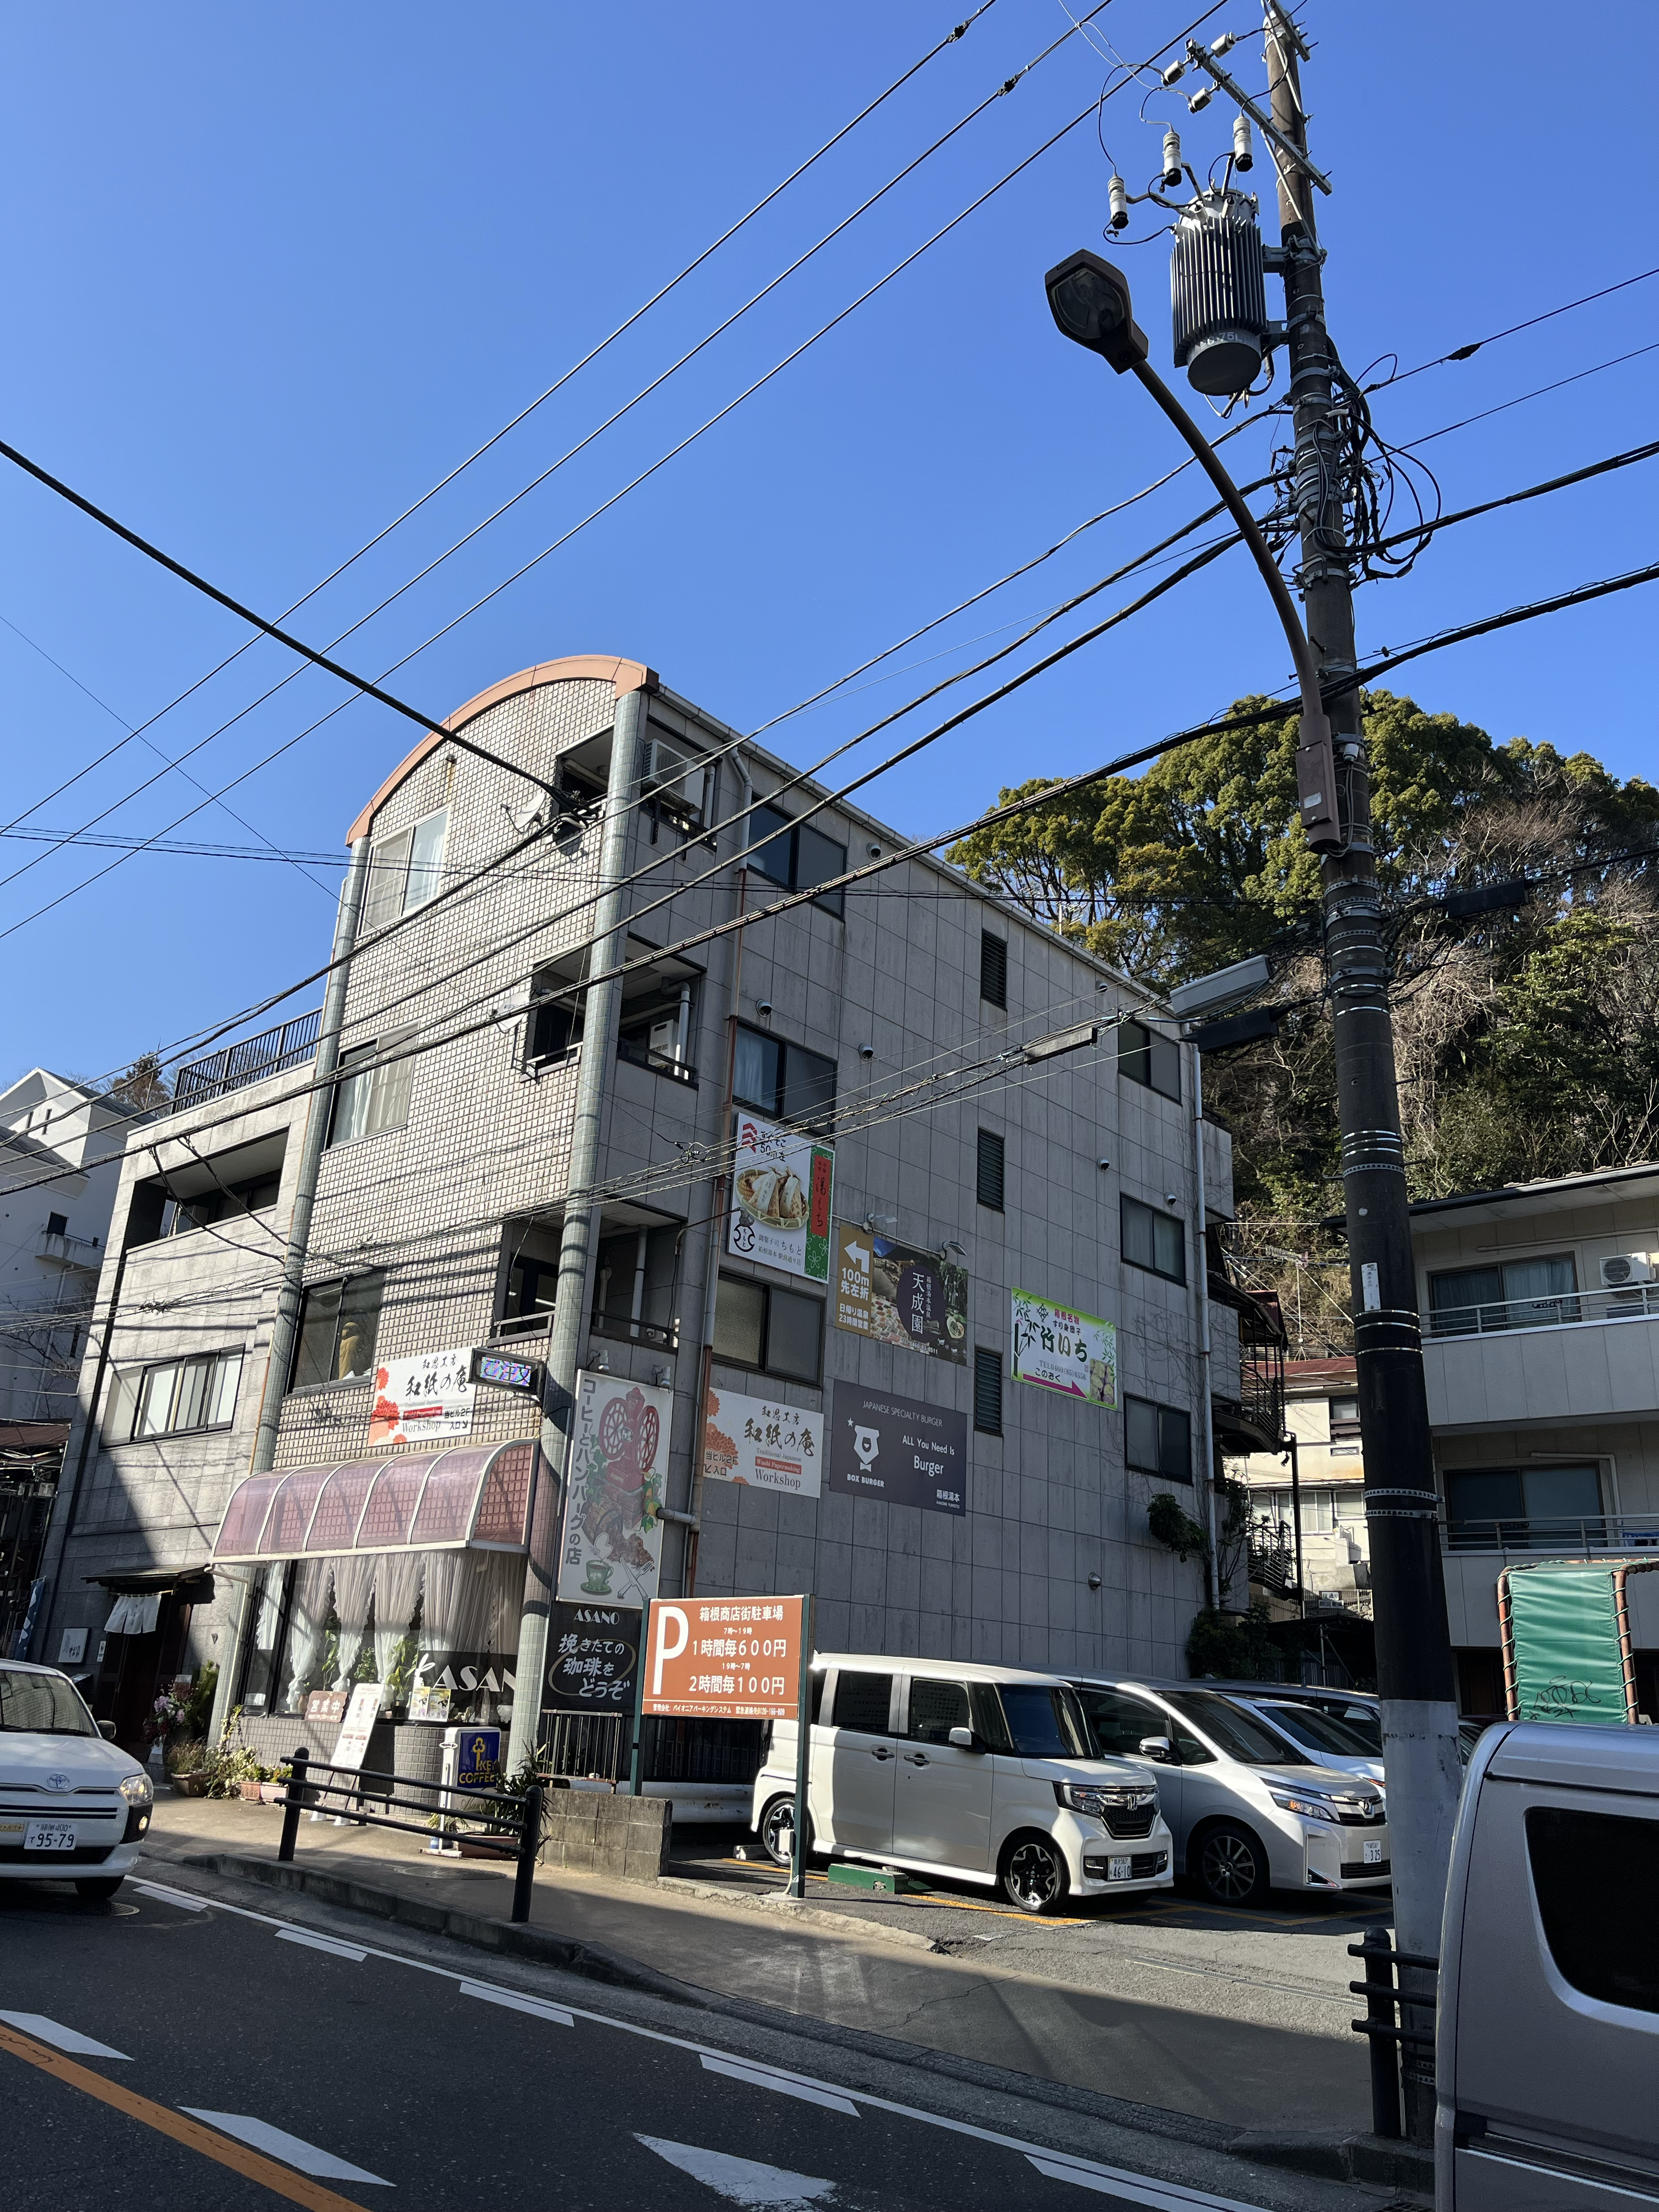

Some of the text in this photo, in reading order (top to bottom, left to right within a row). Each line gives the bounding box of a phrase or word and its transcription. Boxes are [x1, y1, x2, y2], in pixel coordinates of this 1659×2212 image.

[781, 1240, 802, 1256] ちもと
[842, 1267, 870, 1287] 100m
[840, 1280, 869, 1301] 先左折
[839, 1302, 869, 1320] 日帰り温泉
[911, 1272, 925, 1335] 天成園
[1041, 1325, 1087, 1362] 竹いち
[1035, 1367, 1060, 1383] このおく
[862, 1400, 943, 1427] JAPANESE SPECIALTY BURGER
[402, 1421, 441, 1434] Workshop
[449, 1421, 461, 1430] 入口
[757, 1447, 802, 1463] Traditional Japanese
[902, 1435, 955, 1455] ALL You Need Is
[566, 1378, 596, 1565] コーヒーとハンバーグの店
[713, 1466, 727, 1477] 入口
[913, 1455, 944, 1477] Burger
[755, 1469, 801, 1490] Workshop
[847, 1473, 885, 1488] BOX BURGER
[936, 1488, 960, 1503] 箱根湯本
[573, 1609, 620, 1625] ASANO
[699, 1605, 783, 1622] 箱根商店街駐車場
[558, 1633, 624, 1655] 挽きたての
[652, 1606, 689, 1695] P
[693, 1638, 787, 1658] 1時間毎600円
[563, 1656, 614, 1677] 珈琲を
[579, 1677, 630, 1700] どうぞ
[689, 1674, 785, 1695] 2時間毎100円
[673, 1705, 731, 1714] パイオニアパーキングシステム
[36, 1833, 75, 1848] 95-79
